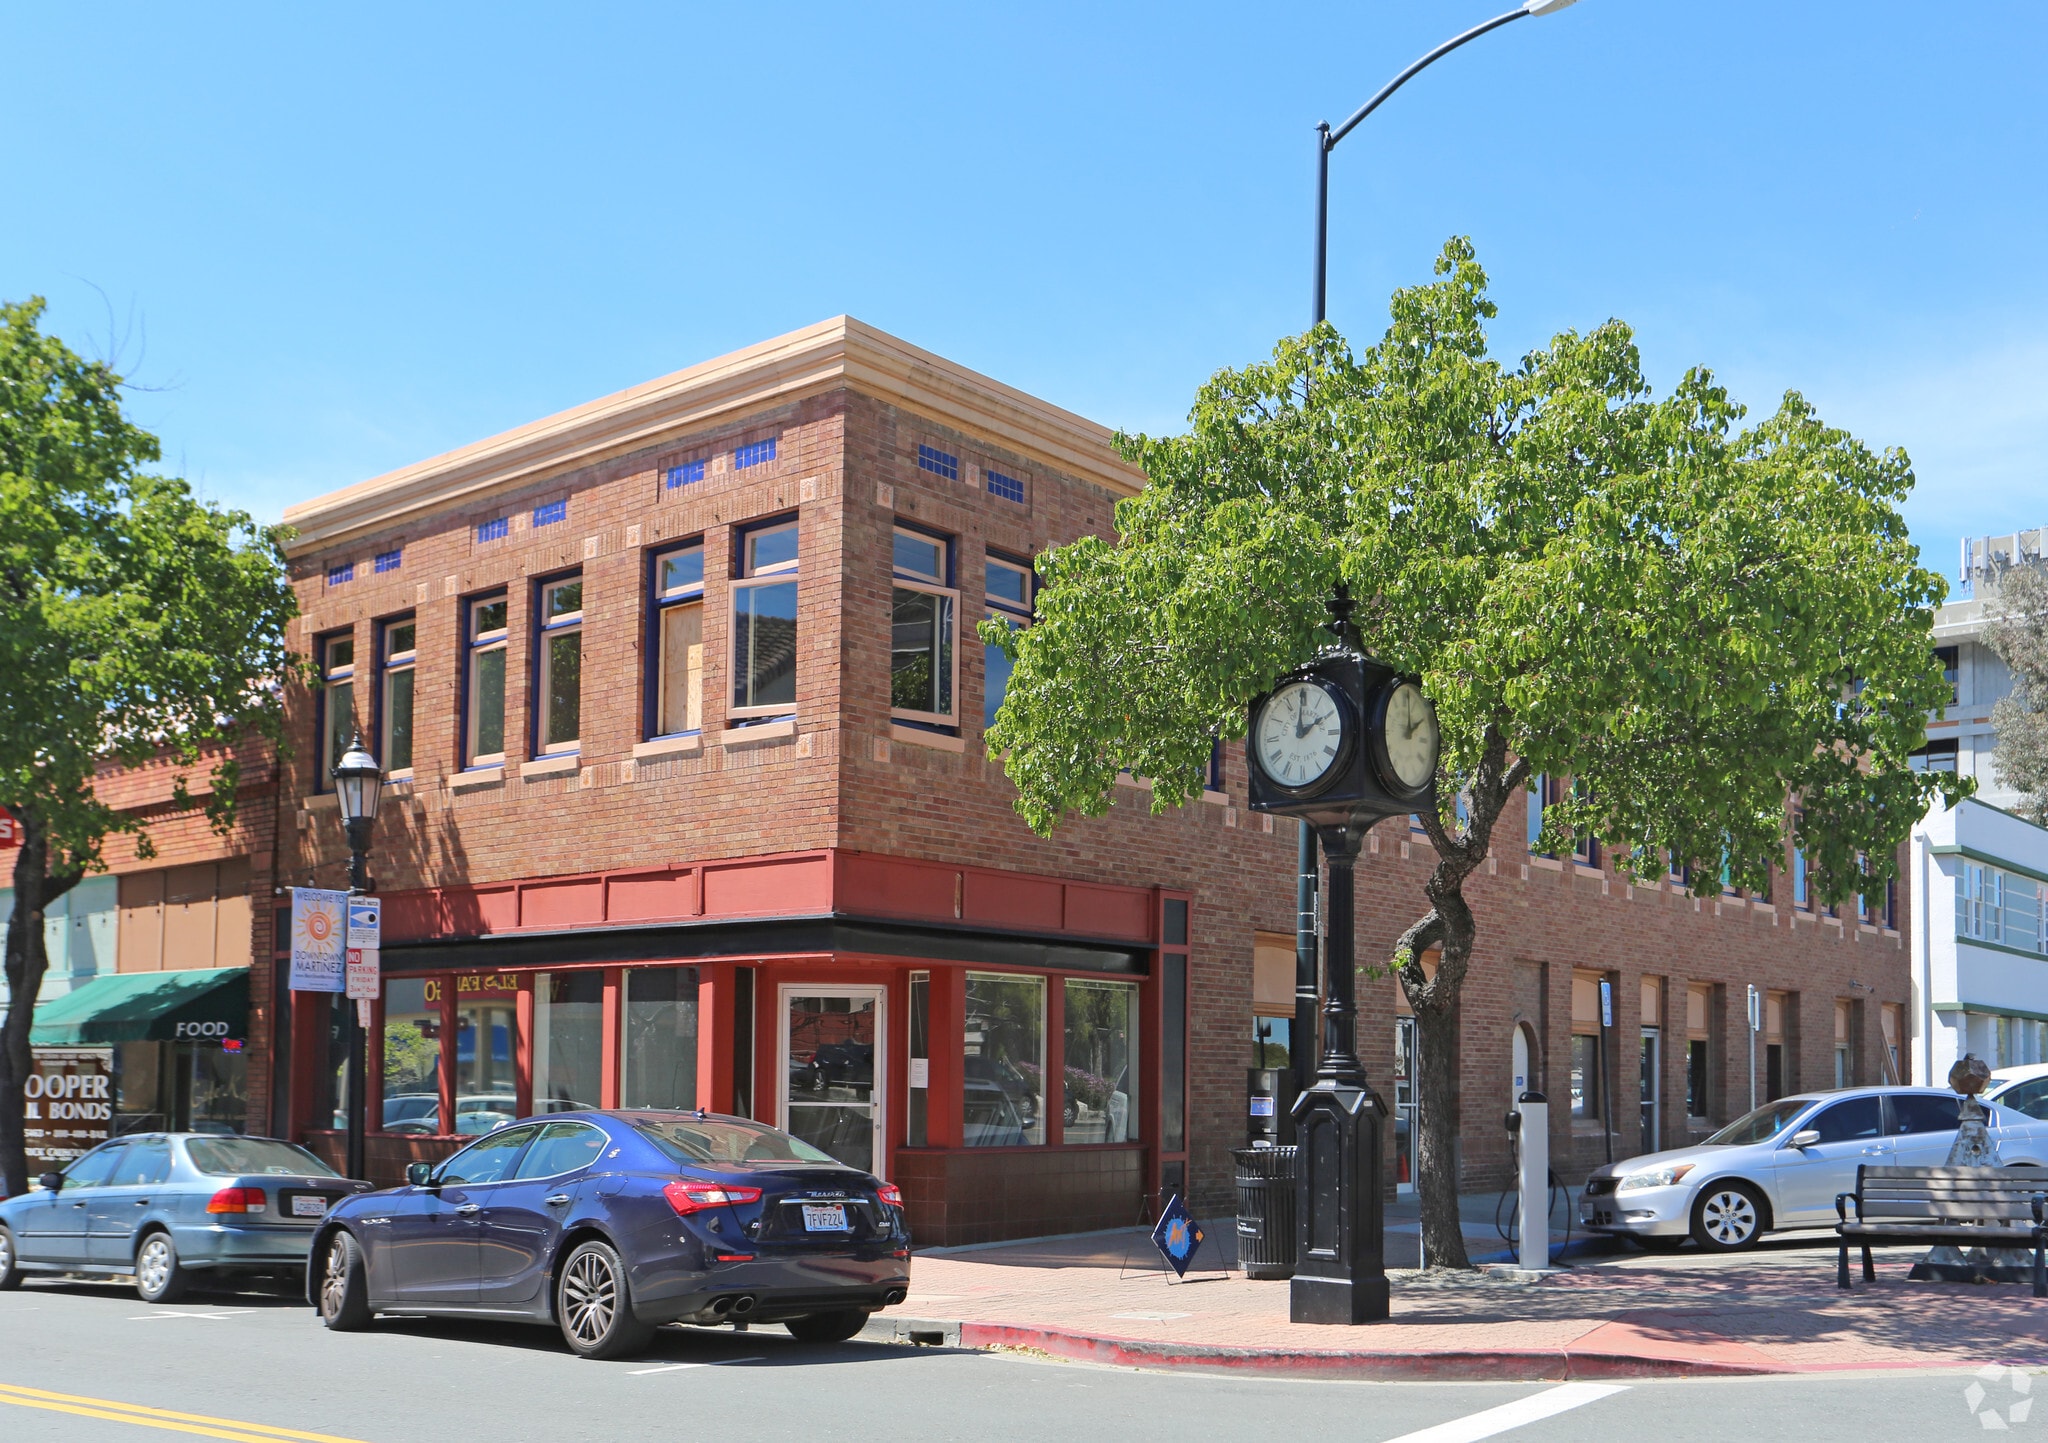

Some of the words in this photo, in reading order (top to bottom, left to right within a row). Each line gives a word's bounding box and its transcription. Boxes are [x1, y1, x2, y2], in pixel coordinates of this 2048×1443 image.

[296, 891, 333, 902] WELCOME
[334, 894, 345, 904] TO
[295, 950, 342, 962] DOWNTOWN
[348, 952, 360, 963] NO
[296, 960, 342, 974] MARTINEZ
[350, 966, 377, 975] PARKING
[176, 1022, 229, 1037] FOOD
[24, 1074, 110, 1099] OOPER
[48, 1102, 112, 1120] BONDS
[806, 1214, 844, 1226] 7FVF224
